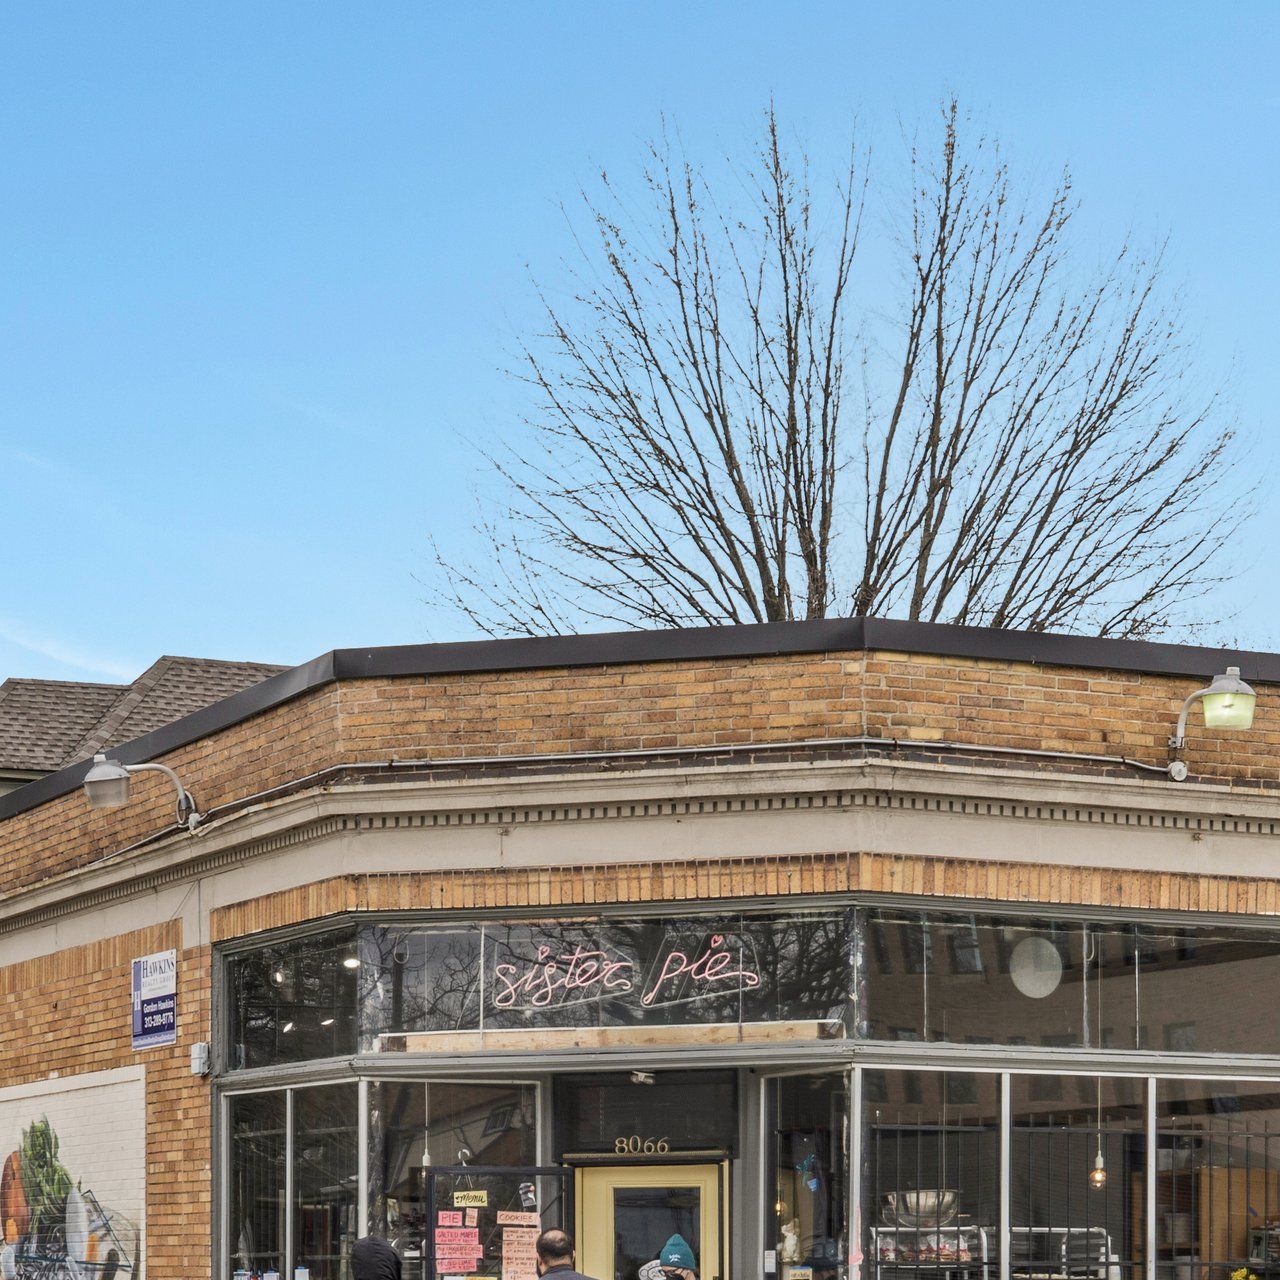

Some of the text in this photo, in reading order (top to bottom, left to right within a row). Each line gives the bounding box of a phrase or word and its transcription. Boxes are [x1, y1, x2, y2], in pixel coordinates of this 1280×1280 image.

[142, 958, 175, 979] HAWKINS
[495, 934, 760, 1006] sister pie
[143, 999, 174, 1014] Gordon Hawkins
[615, 1135, 670, 1155] 8066
[441, 1213, 459, 1224] PIE
[499, 1213, 534, 1223] COOKIES
